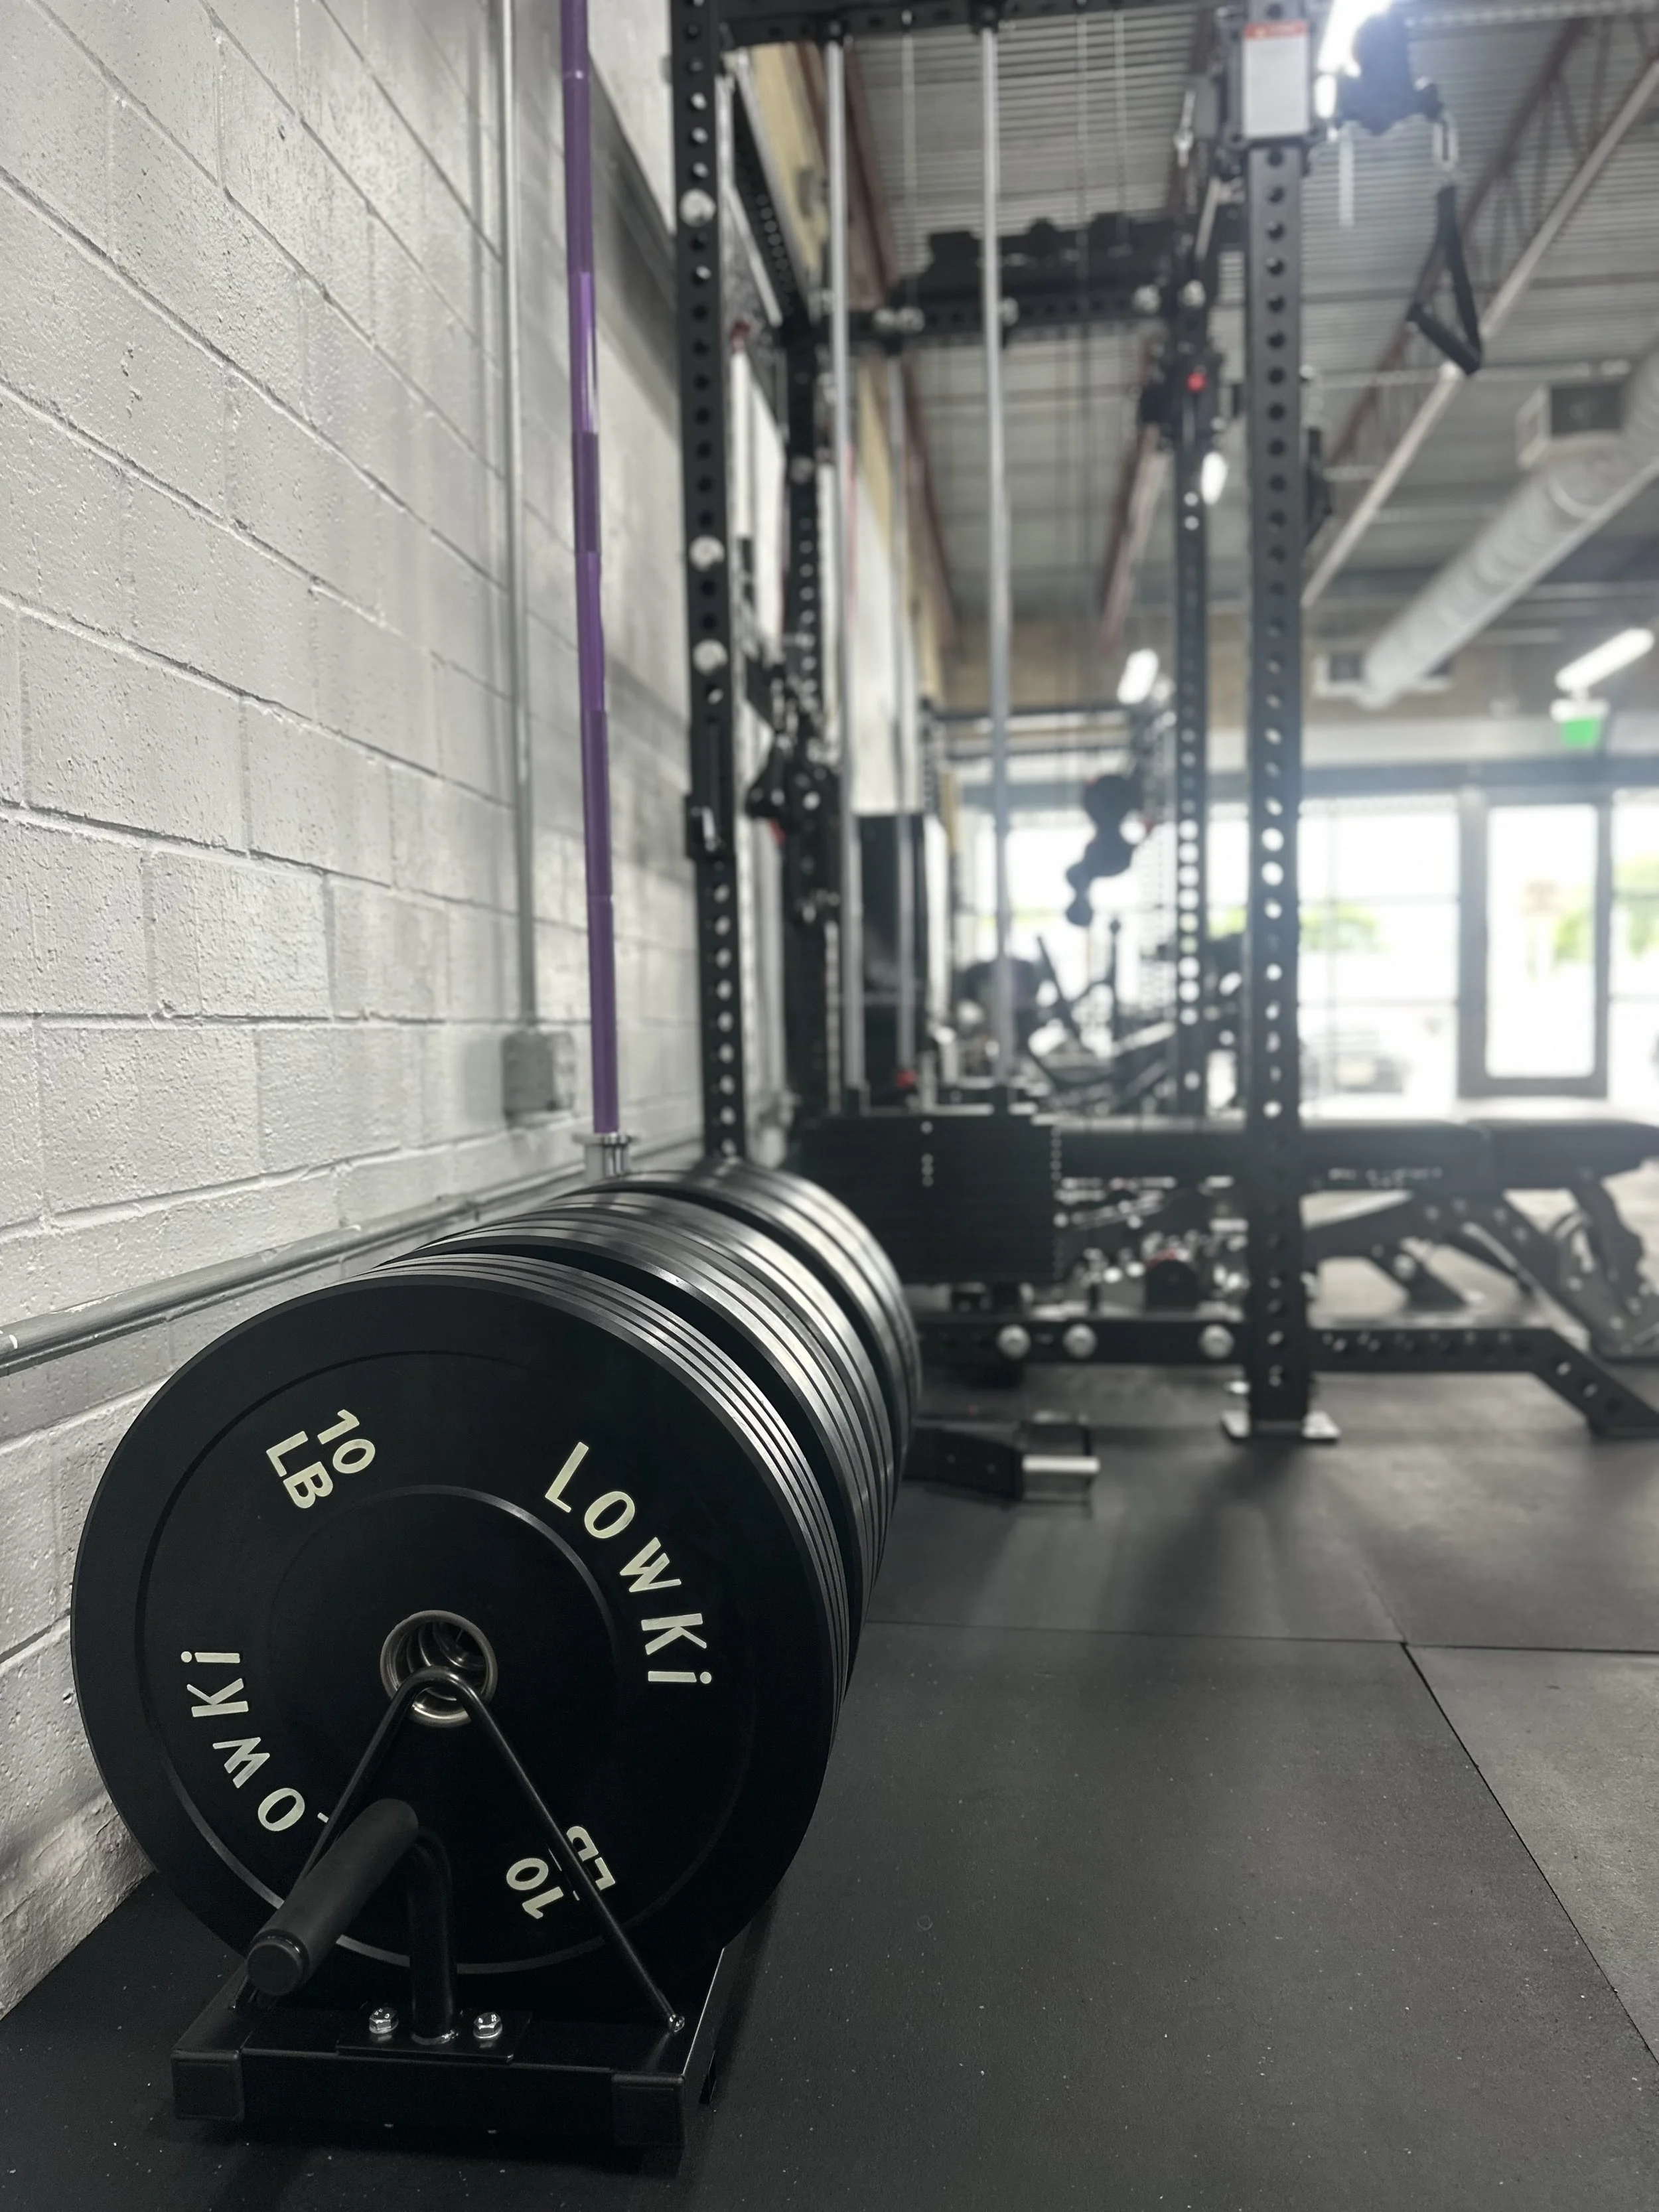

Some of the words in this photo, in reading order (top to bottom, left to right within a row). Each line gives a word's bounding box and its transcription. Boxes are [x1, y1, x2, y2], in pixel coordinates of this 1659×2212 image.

[265, 1430, 334, 1509] LB
[317, 1408, 376, 1475] 10
[180, 1651, 330, 1832] OWKi
[506, 1858, 564, 1919] 10
